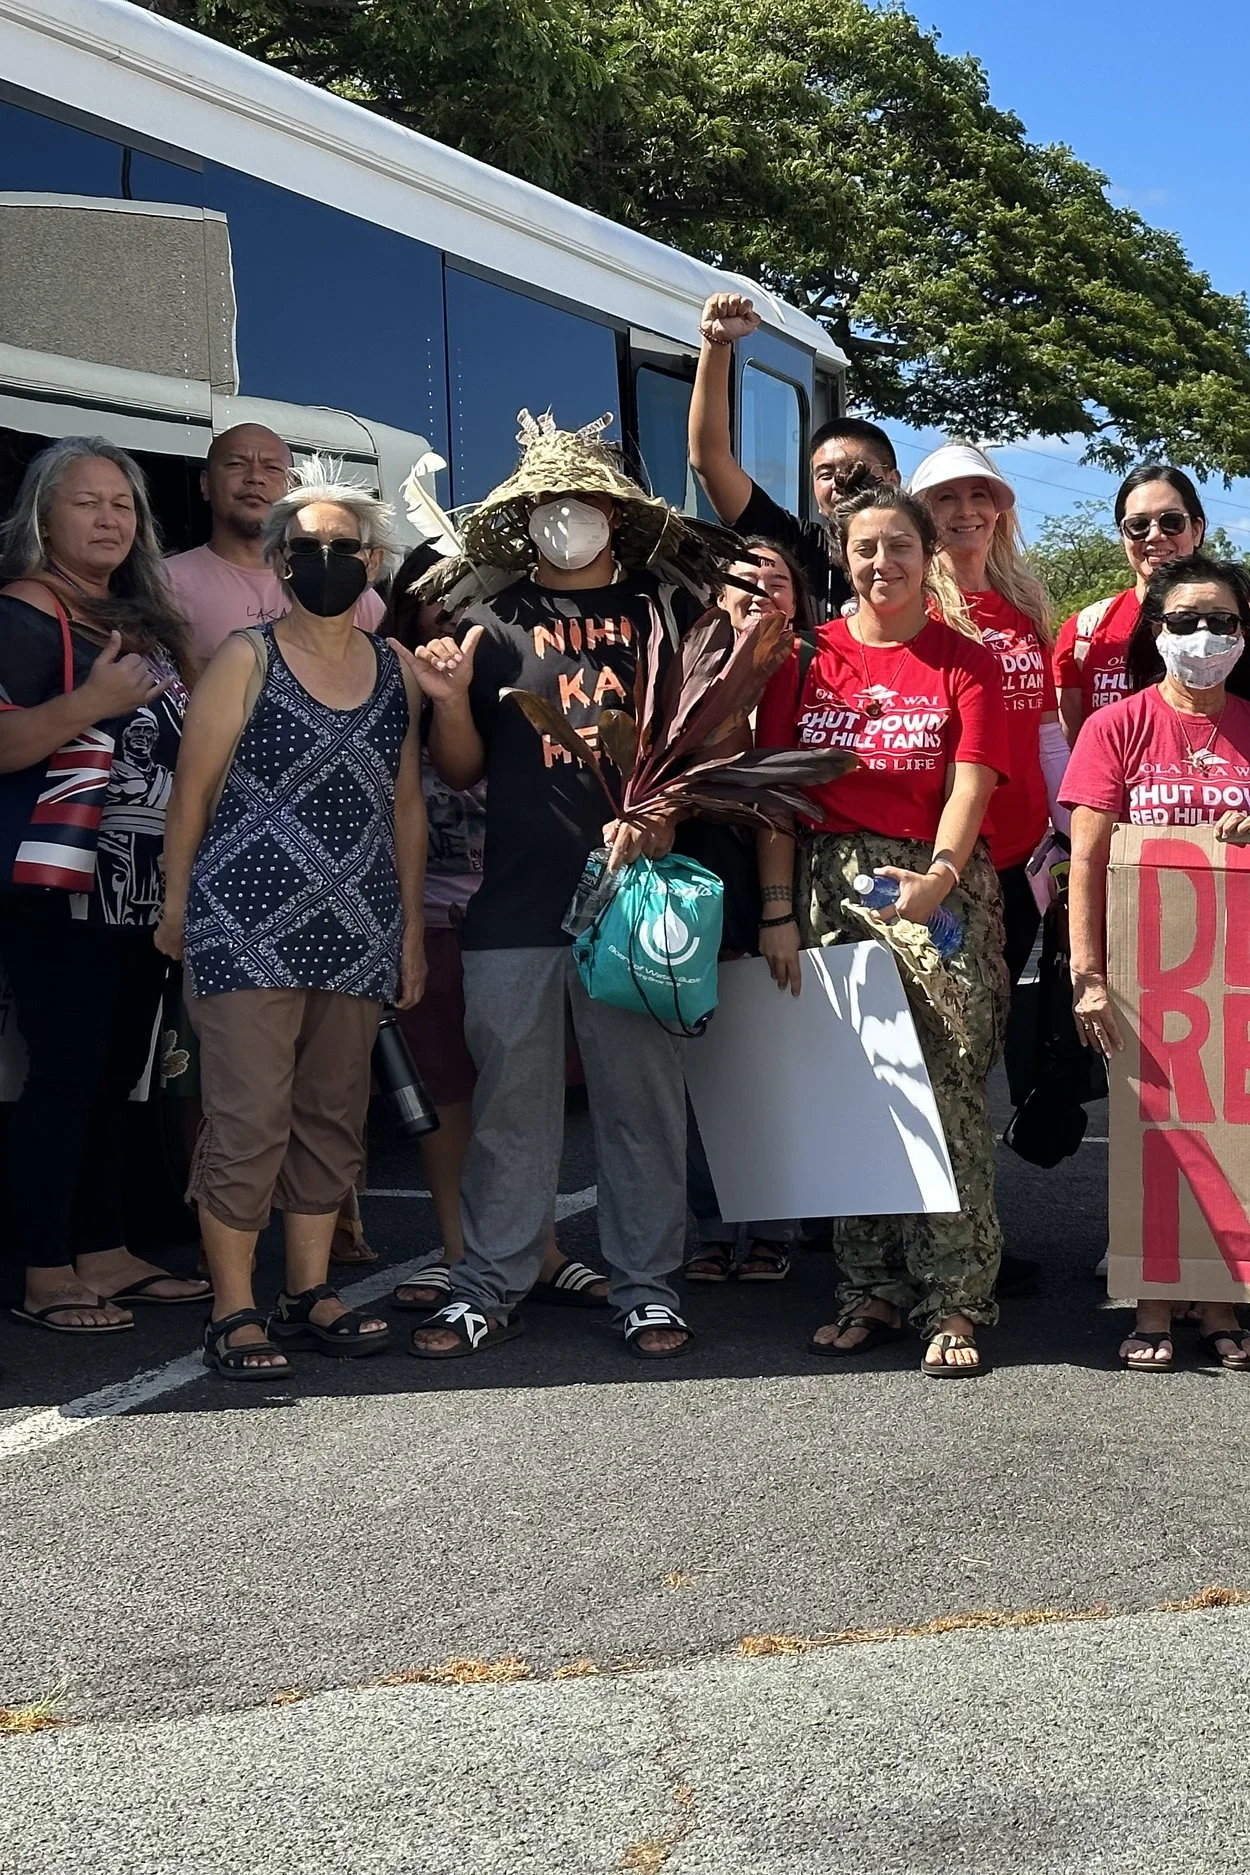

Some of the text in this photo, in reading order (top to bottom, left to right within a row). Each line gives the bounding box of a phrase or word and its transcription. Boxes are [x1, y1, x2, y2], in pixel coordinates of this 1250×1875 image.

[534, 616, 632, 660] NIHI
[1002, 651, 1044, 673] DOW
[1107, 657, 1126, 667] OL
[1020, 674, 1044, 689] TAN
[1093, 673, 1133, 690] SHU
[558, 666, 627, 715] KA
[902, 695, 939, 706] WAI
[798, 711, 949, 736] SHUT DOWN
[801, 728, 827, 744] ED
[830, 731, 878, 748] HILL
[869, 758, 936, 771] IS LIFE
[1139, 763, 1182, 774] OLA
[1129, 784, 1195, 807] SHUT
[1129, 808, 1169, 825] RED
